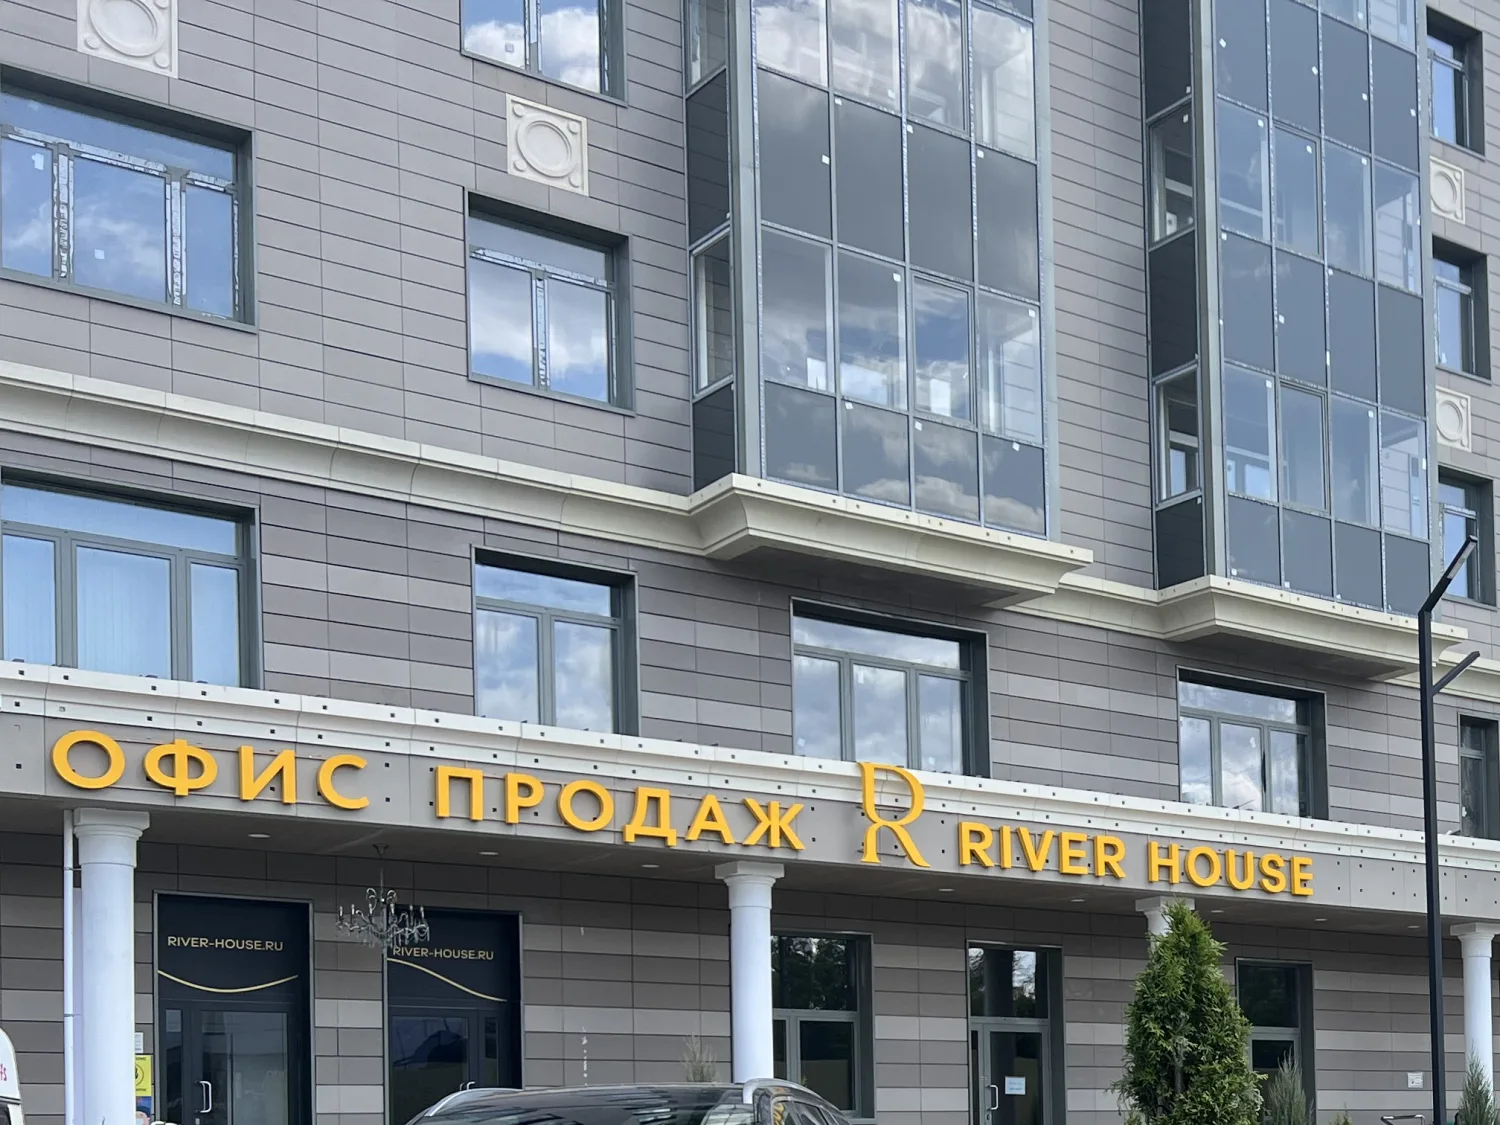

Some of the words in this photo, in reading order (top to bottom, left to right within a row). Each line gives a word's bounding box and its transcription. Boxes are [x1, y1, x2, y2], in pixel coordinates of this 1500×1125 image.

[52, 730, 371, 810] ОФИС
[435, 765, 806, 850] ПРОДАЖ
[958, 821, 1127, 878] RIVER
[1148, 841, 1314, 896] HOUSE
[167, 936, 284, 951] RIVER-HOUSE.RU
[392, 945, 495, 960] RIVER-HOUSE.RU
